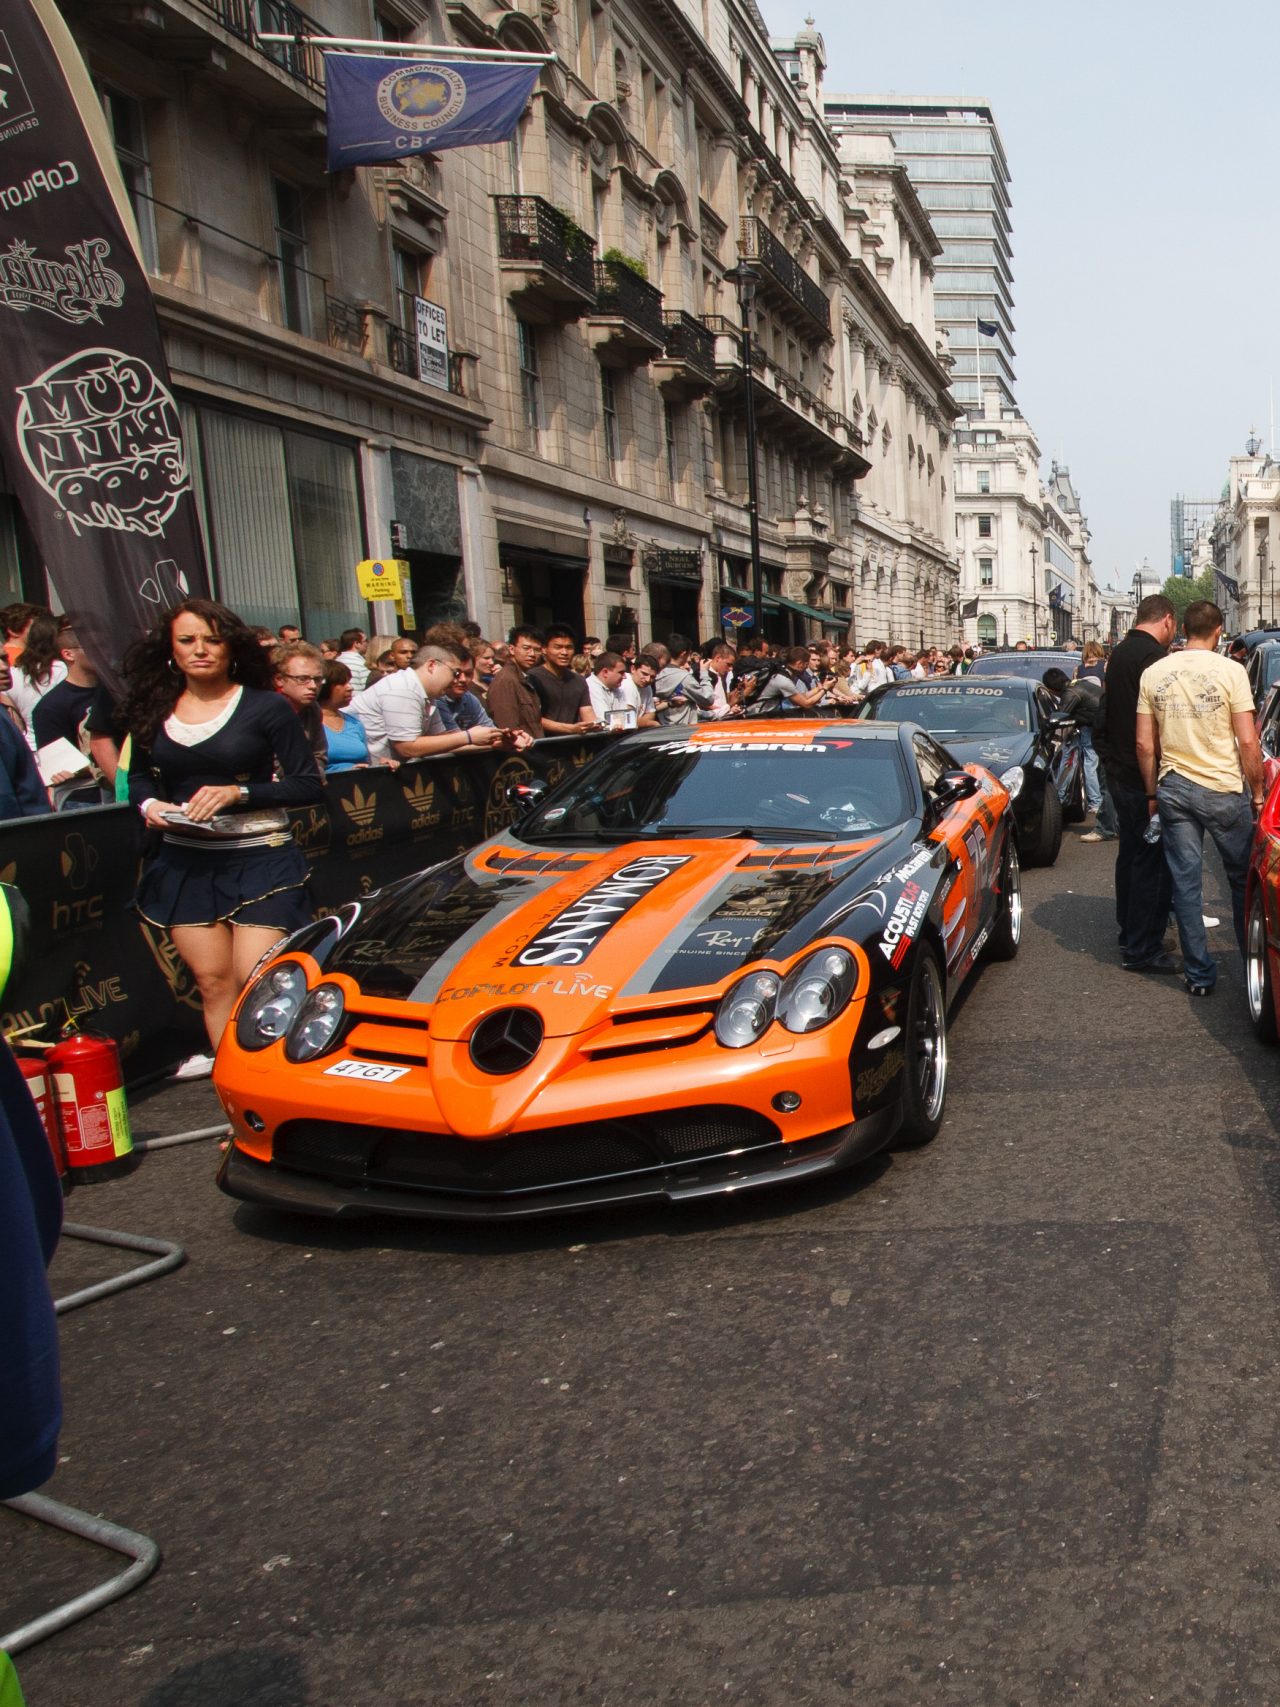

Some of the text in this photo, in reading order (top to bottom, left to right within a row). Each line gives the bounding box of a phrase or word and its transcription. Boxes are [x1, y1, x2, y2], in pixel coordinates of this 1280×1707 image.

[382, 65, 464, 90] COMMONWEALTH
[379, 96, 462, 130] BUSINESS COUNCIL
[416, 301, 445, 325] OFFICES
[418, 320, 446, 345] TO LET
[896, 687, 1004, 697] GUMBALL 3000
[411, 812, 440, 829] adidas
[347, 825, 383, 846] adidas
[518, 855, 692, 966] ROMANS
[878, 879, 921, 961] ACOUSTICAR
[905, 917, 918, 937] FAST
[334, 1063, 402, 1079] 47GT
